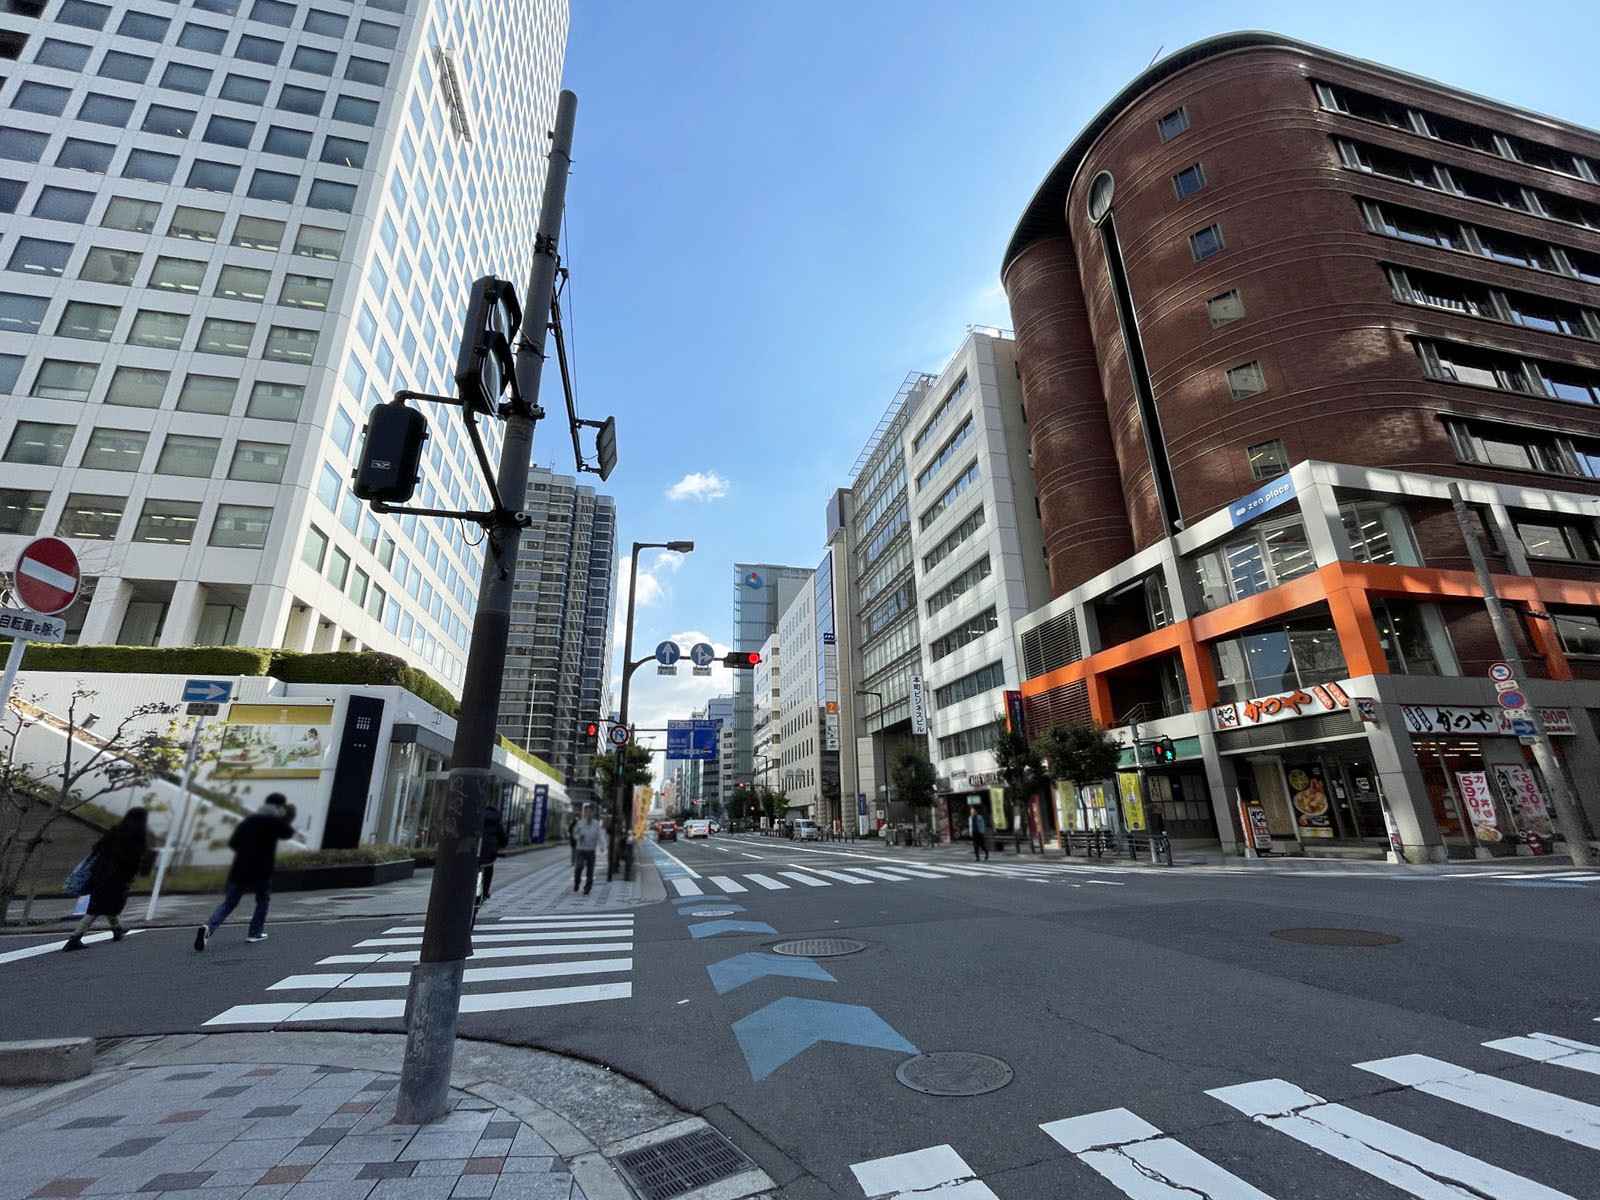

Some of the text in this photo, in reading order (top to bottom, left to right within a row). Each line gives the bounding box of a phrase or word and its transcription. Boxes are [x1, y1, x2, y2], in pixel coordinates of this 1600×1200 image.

[1247, 483, 1290, 510] zen place
[0, 614, 62, 639] 自転車を除く
[913, 676, 924, 733] 本町ビジネスビル
[1244, 690, 1313, 724] かつや
[1436, 707, 1493, 732] かつや
